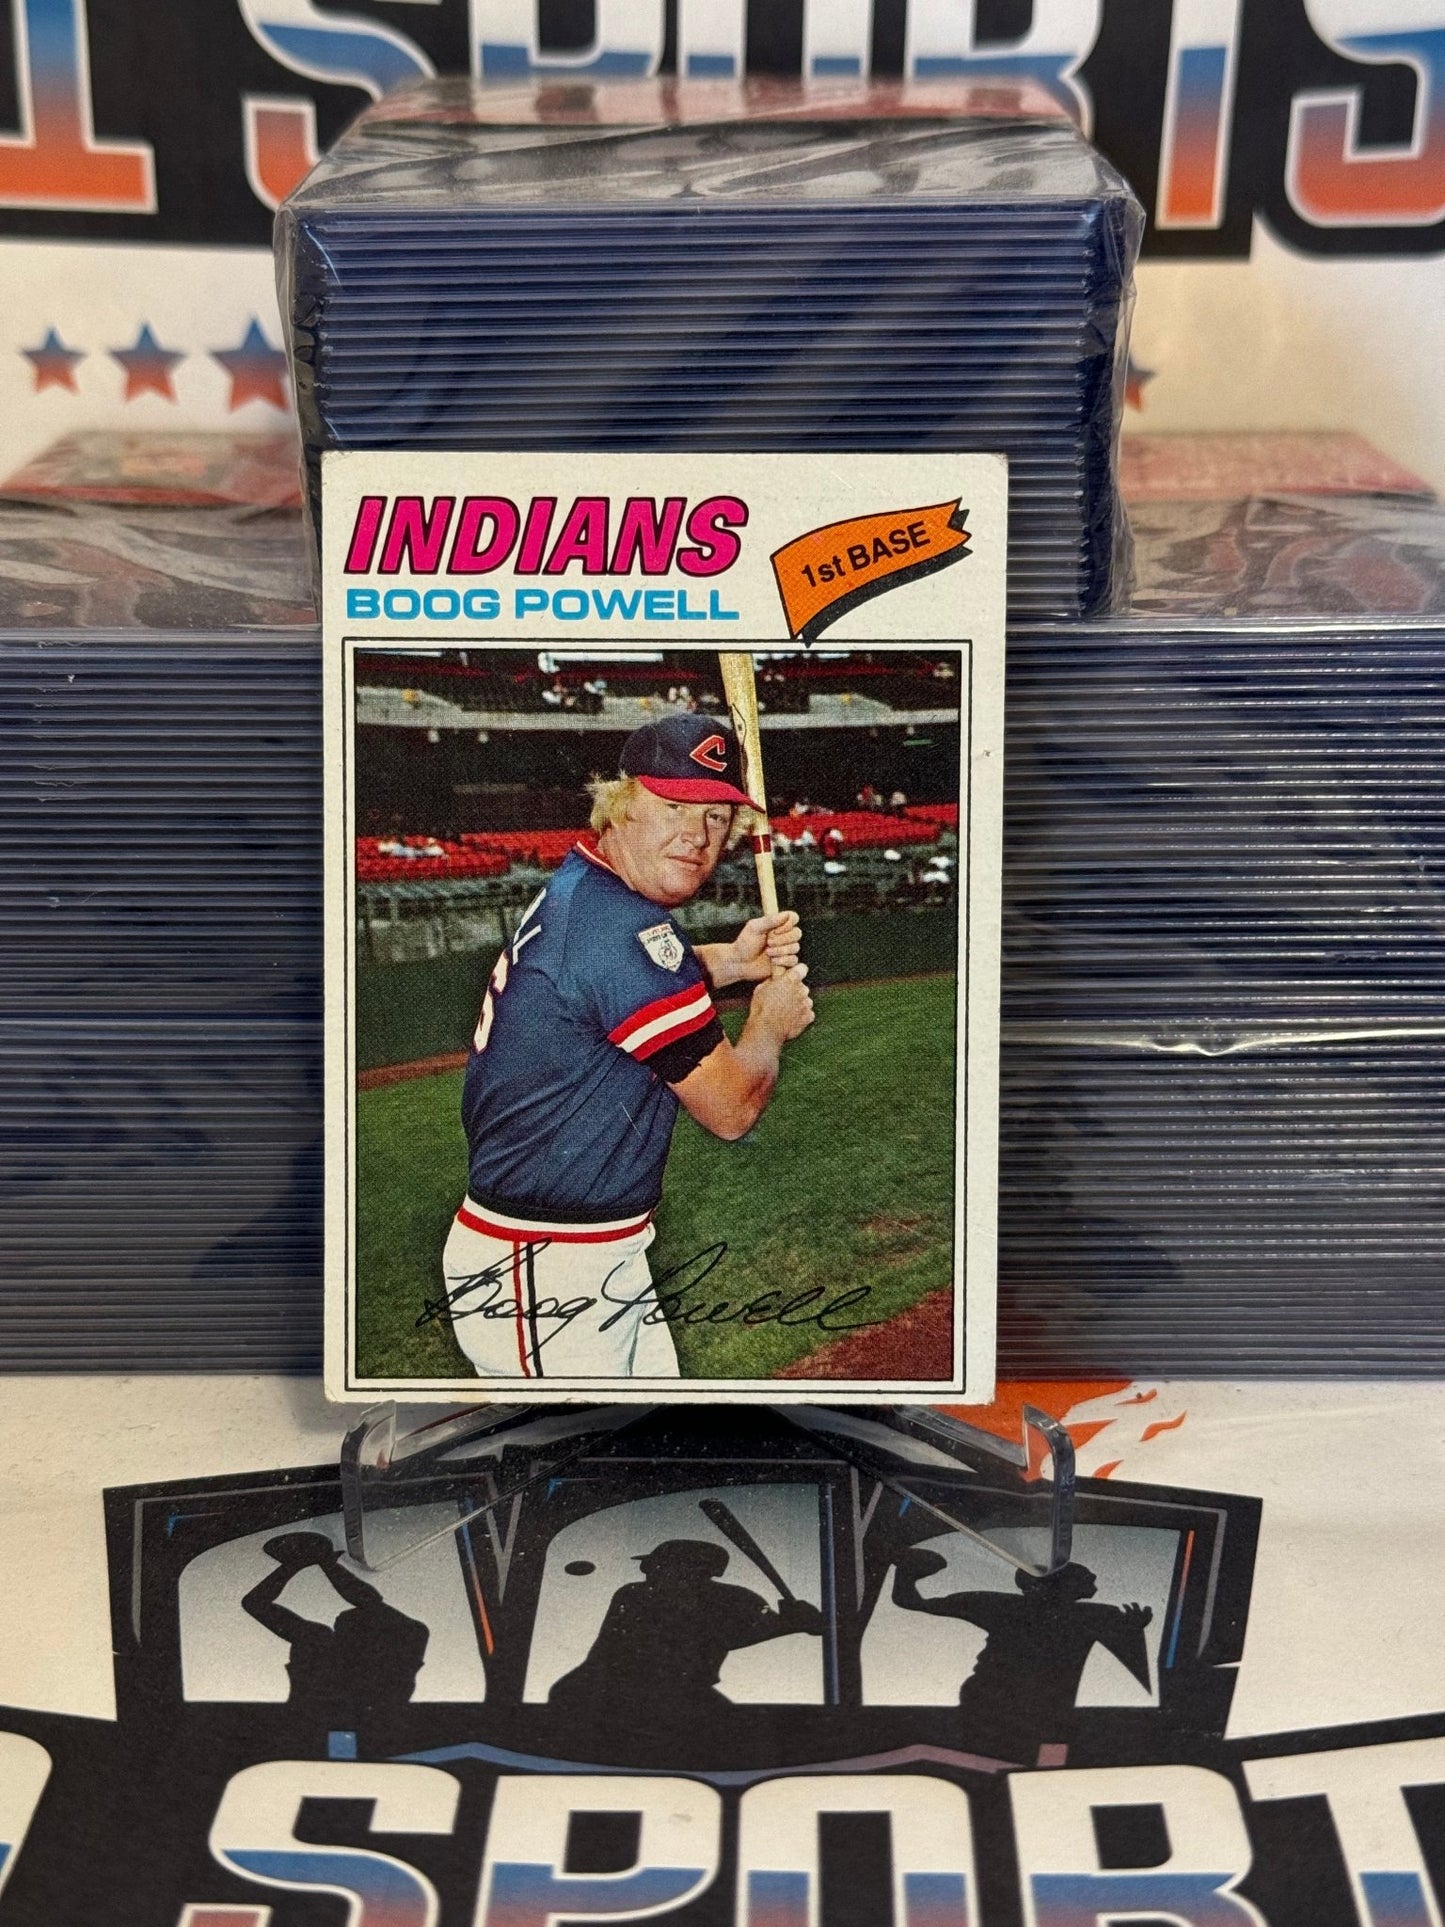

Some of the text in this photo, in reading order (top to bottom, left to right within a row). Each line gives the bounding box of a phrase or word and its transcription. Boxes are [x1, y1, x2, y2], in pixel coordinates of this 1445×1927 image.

[344, 495, 749, 577] INDIANS
[801, 521, 931, 590] 1st BASE
[346, 588, 740, 621] BOOG POWELL
[599, 1241, 887, 1332] Powell
